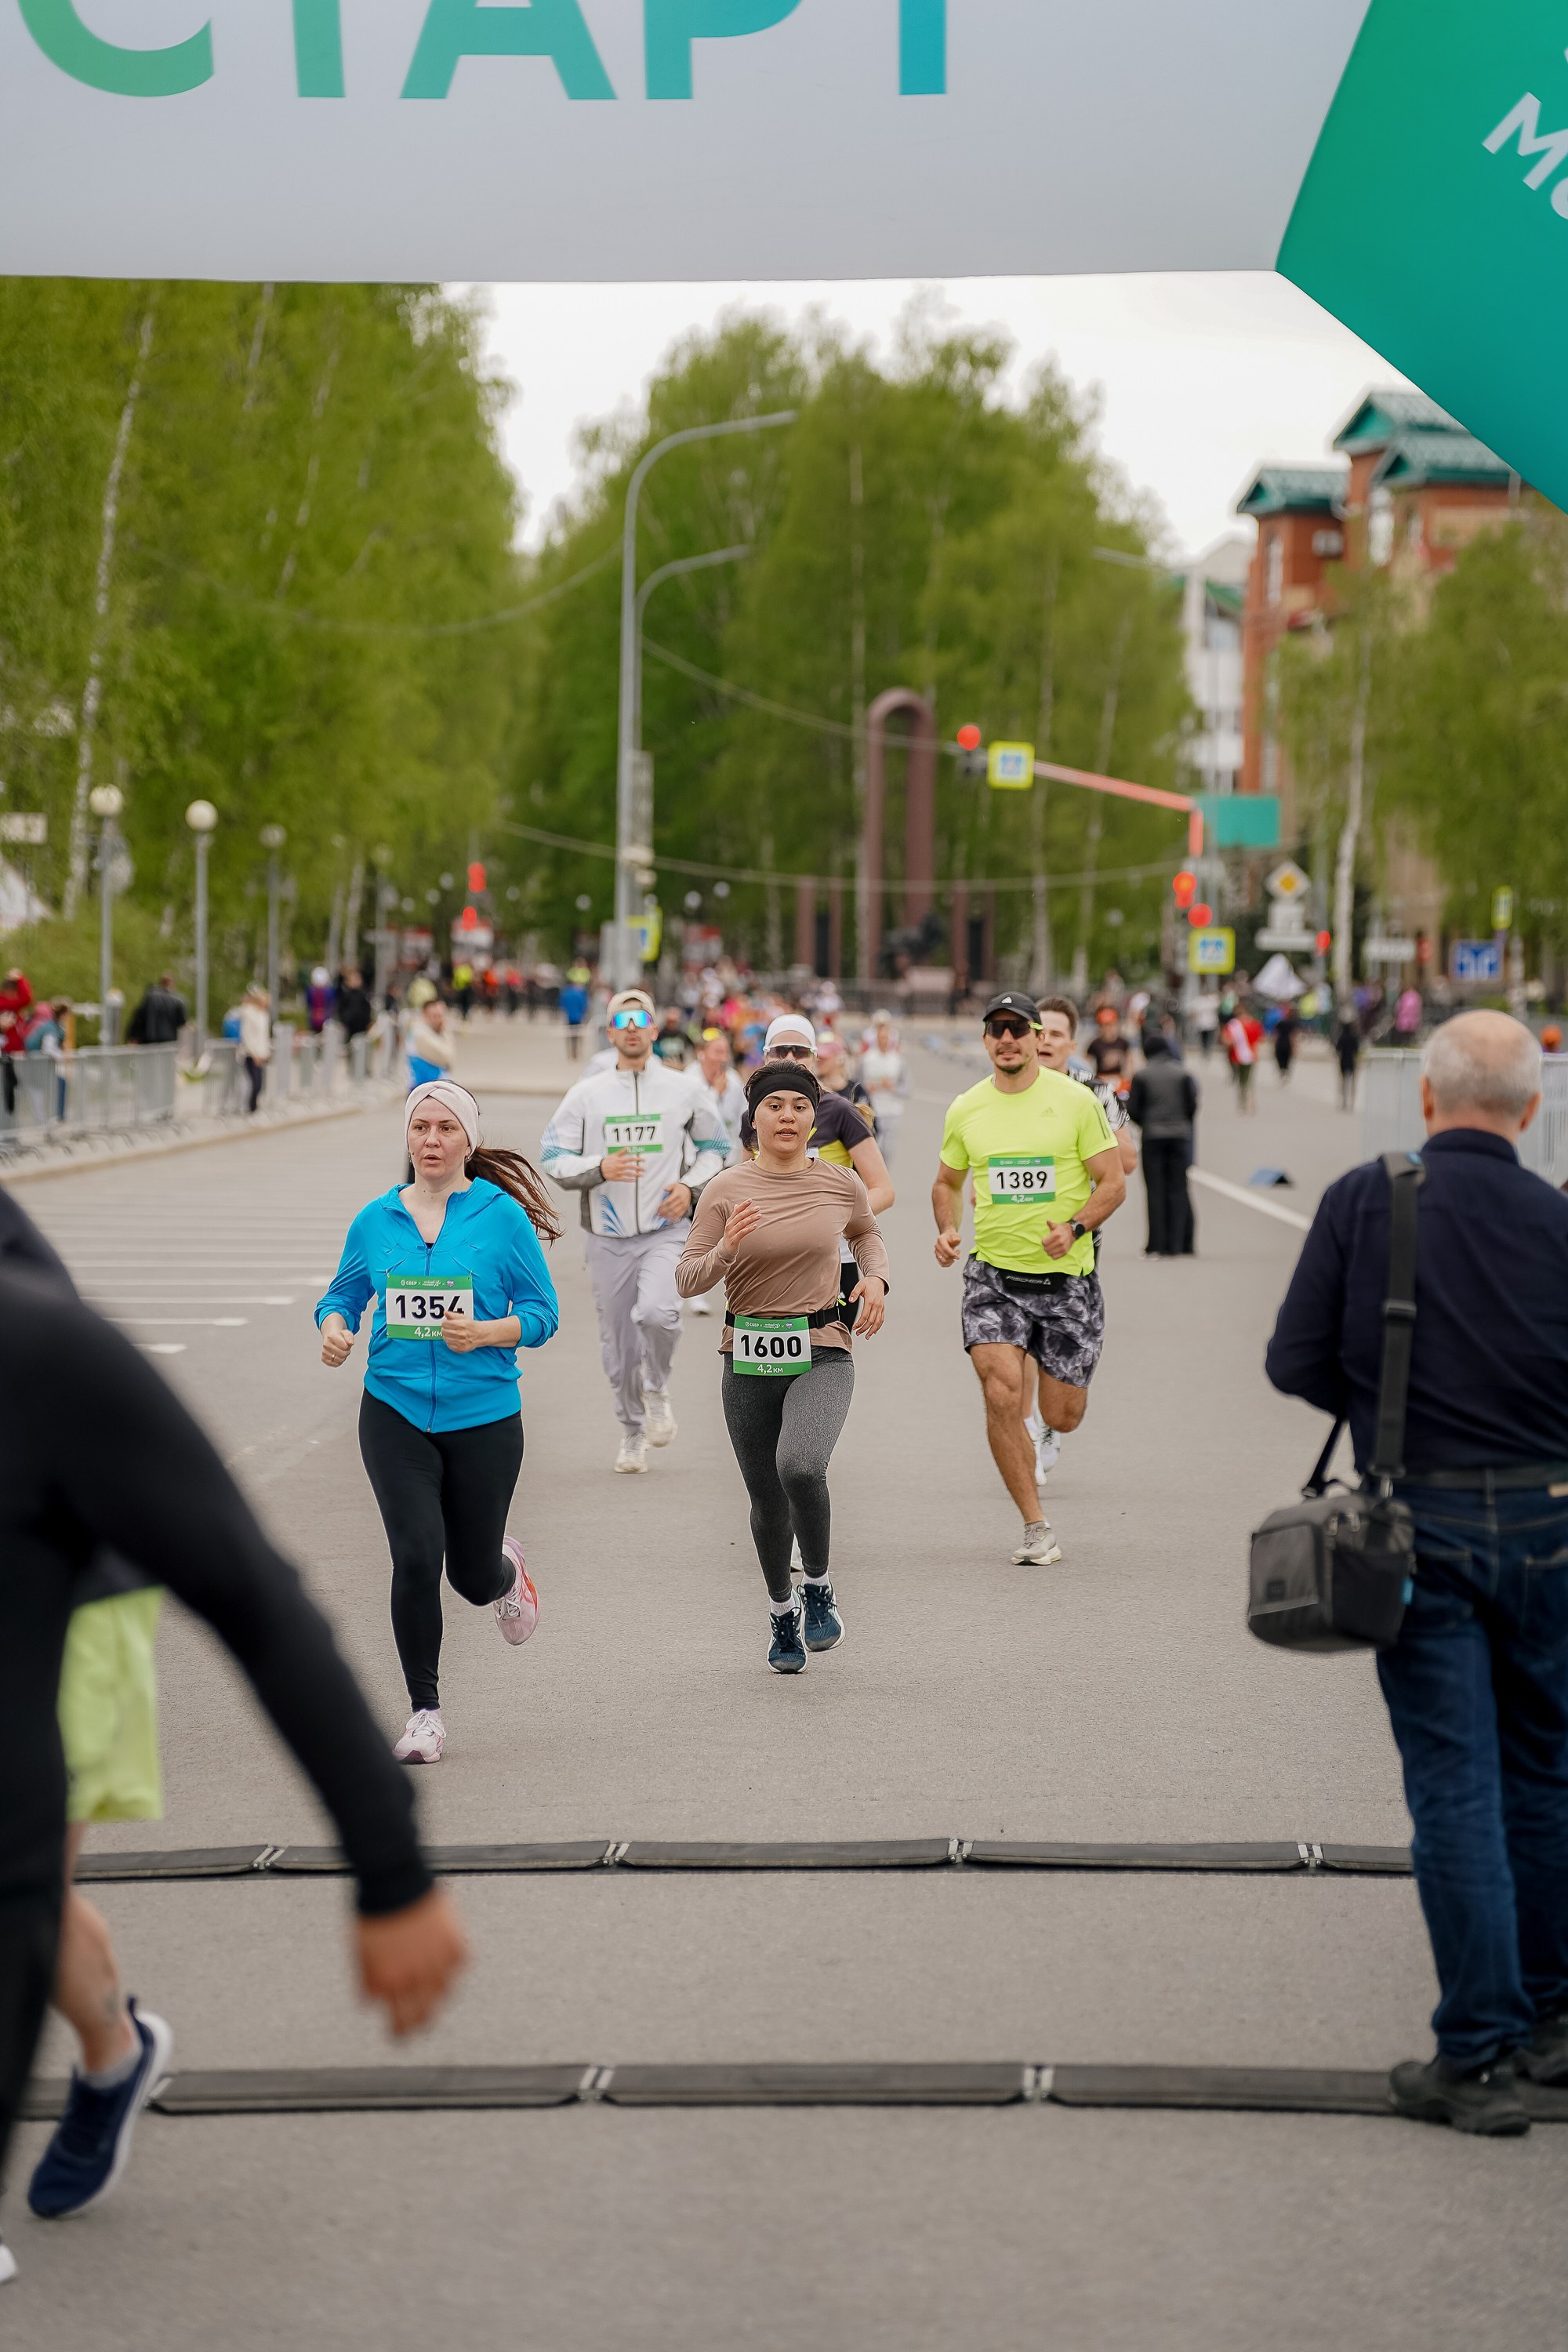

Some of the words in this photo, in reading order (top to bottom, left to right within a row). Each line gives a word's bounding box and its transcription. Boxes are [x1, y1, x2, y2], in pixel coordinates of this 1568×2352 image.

[613, 1126, 656, 1142] 1177
[996, 1171, 1047, 1189] 1389
[395, 1294, 465, 1320] 1354
[740, 1334, 802, 1358] 1600
